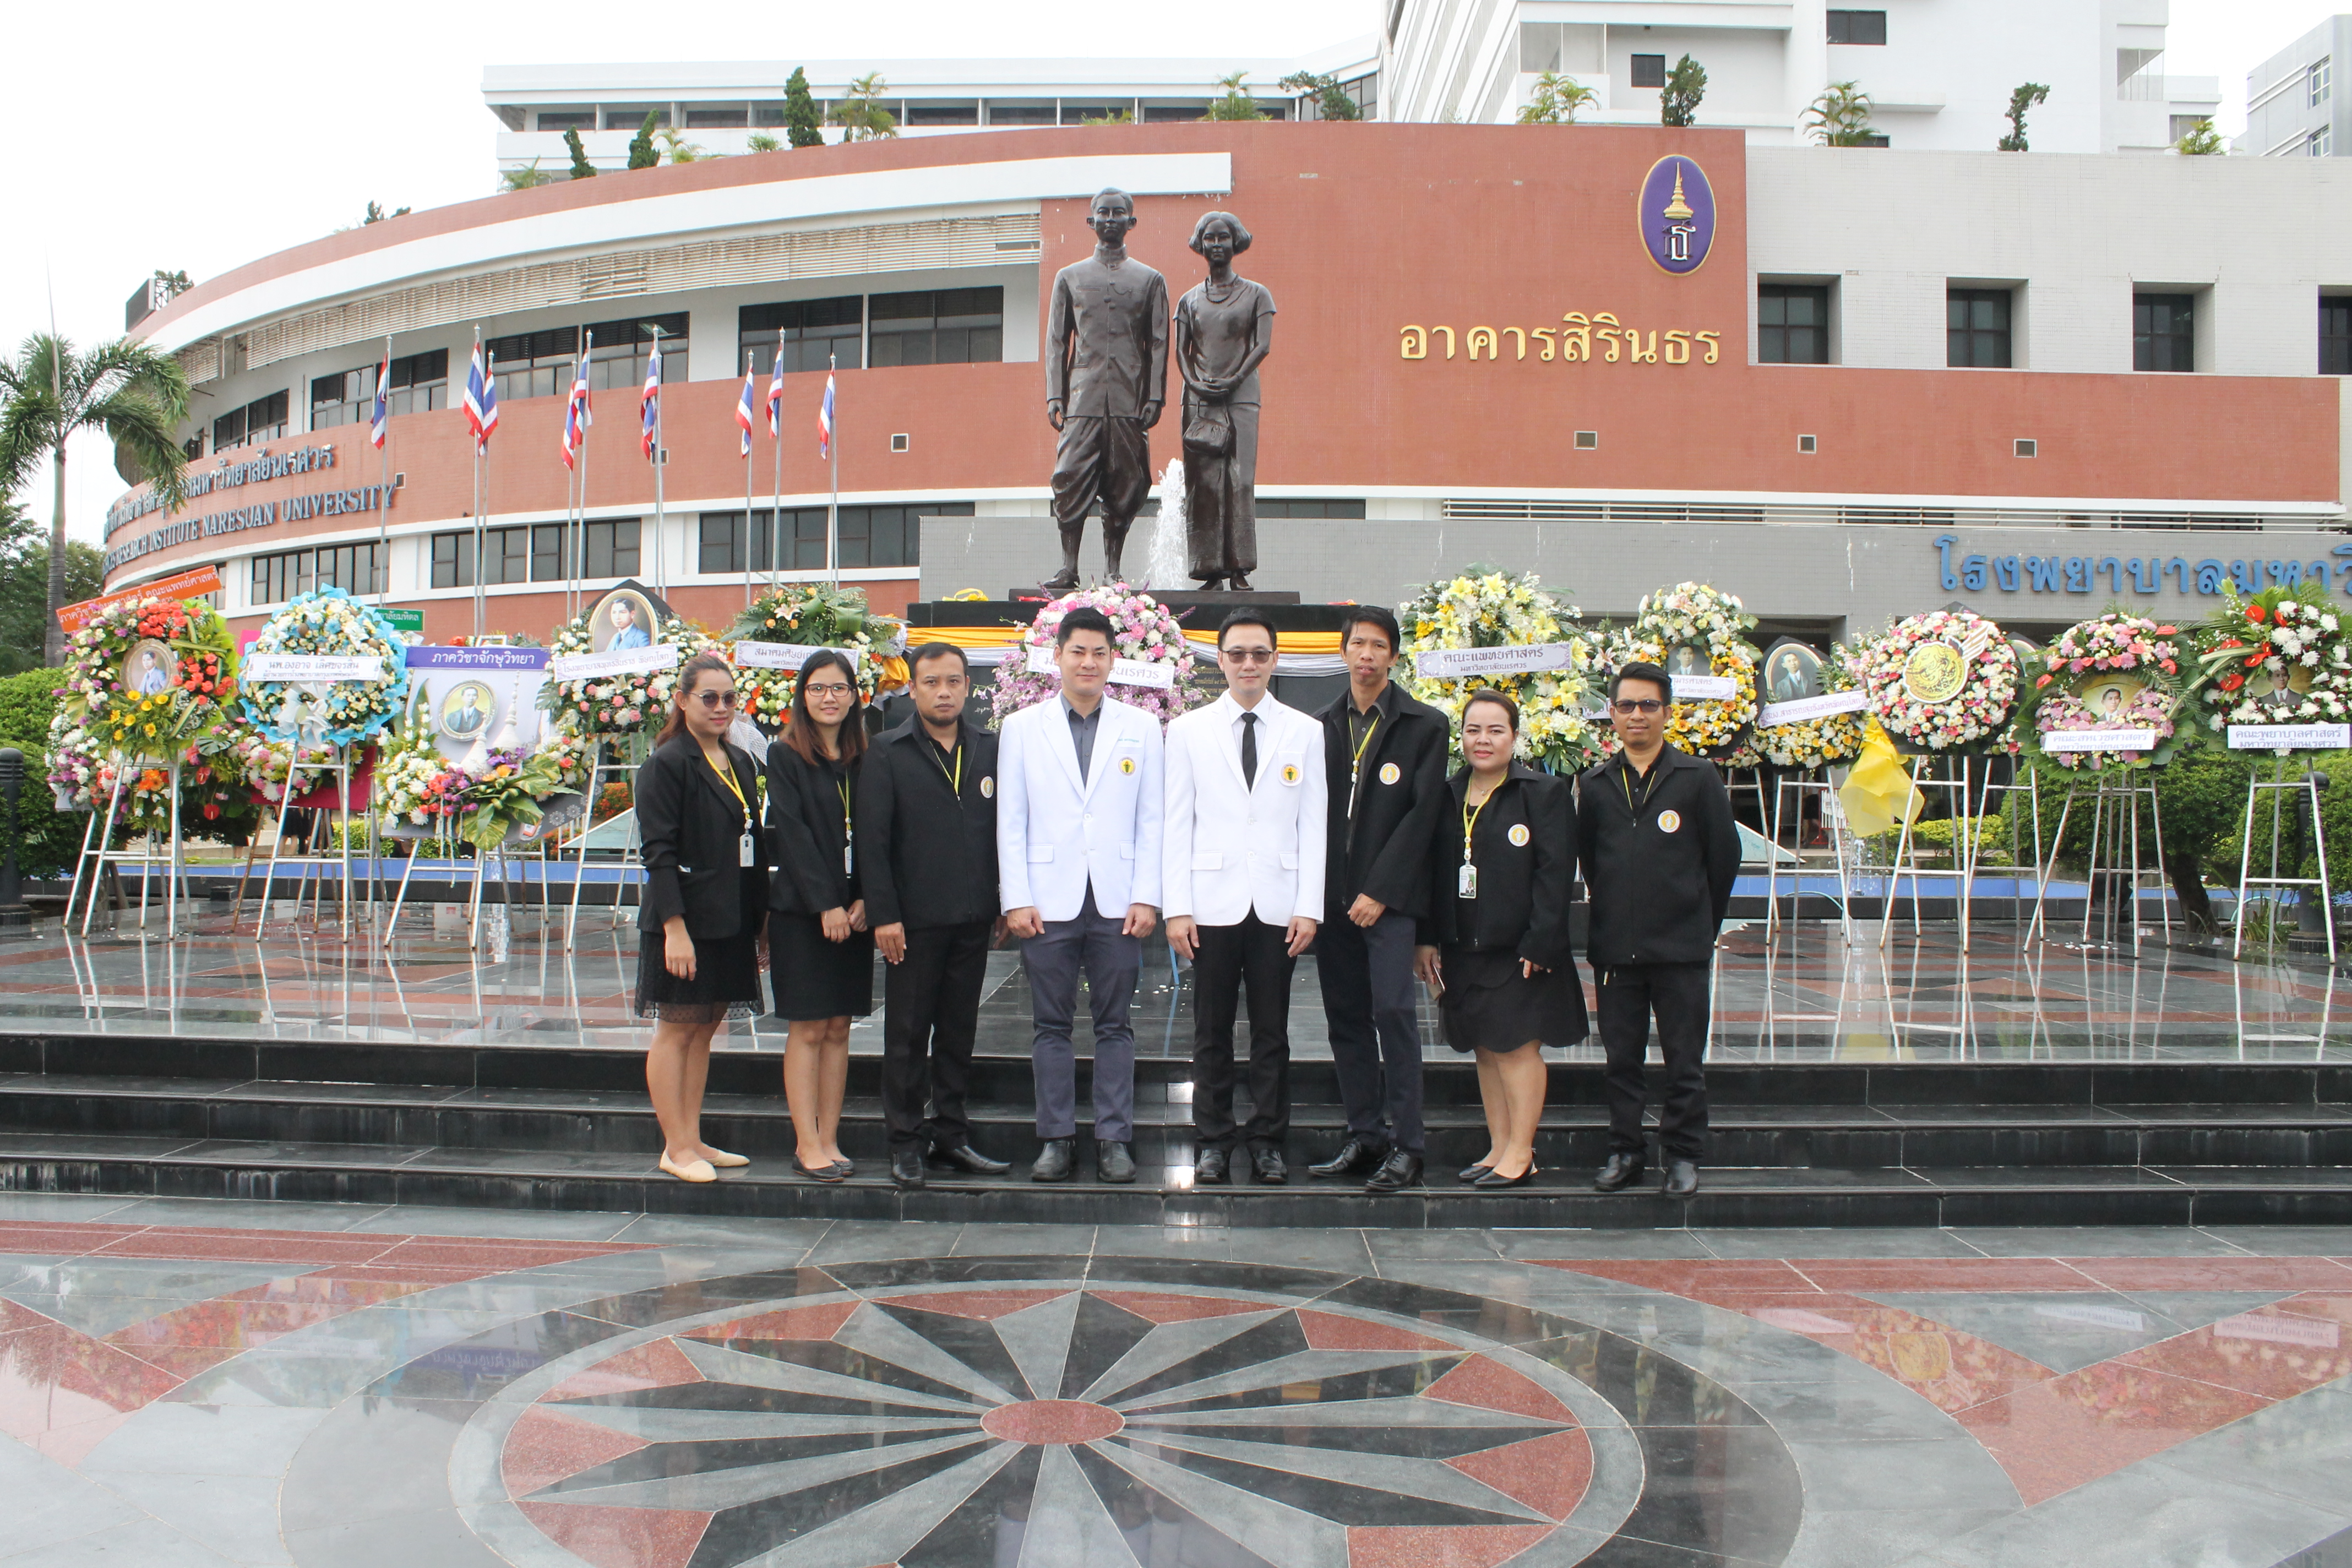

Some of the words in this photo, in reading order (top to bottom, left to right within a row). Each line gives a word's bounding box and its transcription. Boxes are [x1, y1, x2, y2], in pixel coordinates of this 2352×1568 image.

[1400, 311, 1721, 365] อาคารสิรินธร
[149, 518, 200, 552] INSTITUTE
[203, 502, 275, 537] NARESUAN
[281, 483, 396, 522] UNIVERSITY
[432, 650, 535, 668] ภาควิชาจักษุวิทยา
[1443, 647, 1544, 664] คณะแพทยศาสตร์
[1460, 662, 1527, 673] มหาวิทยาลัยนเรศวร
[2053, 729, 2149, 743] คณะสหเวชศาสตร์
[2236, 725, 2343, 738] คณะพยาบาลศาสตร์
[2056, 741, 2143, 750] มหาวิทยาลัยนเรศวร
[2239, 738, 2338, 748] มหาวิทยาลัยนเรศวร
